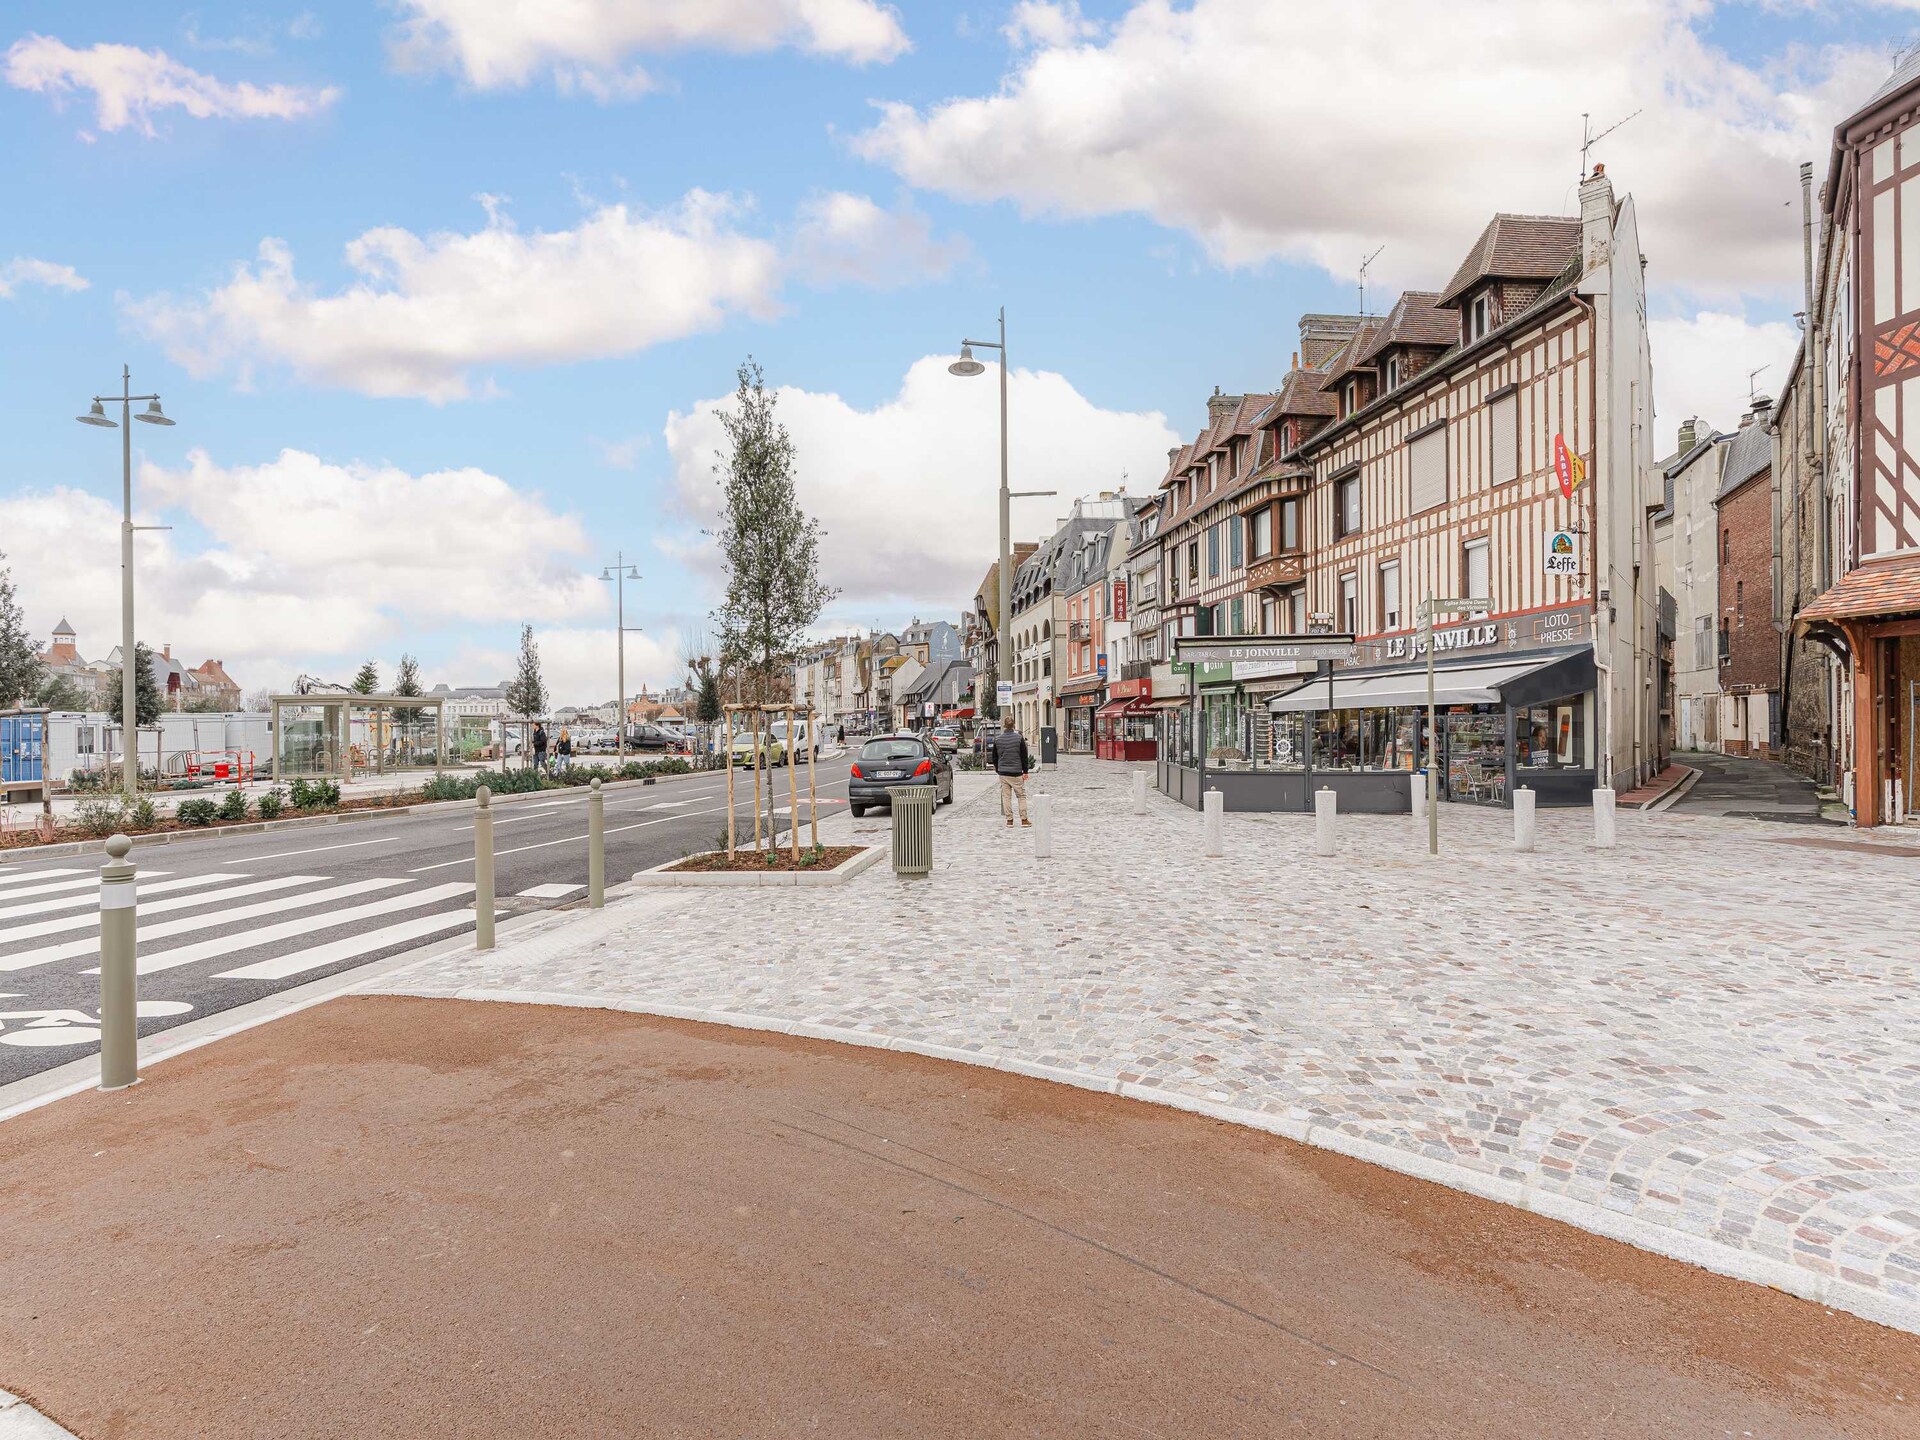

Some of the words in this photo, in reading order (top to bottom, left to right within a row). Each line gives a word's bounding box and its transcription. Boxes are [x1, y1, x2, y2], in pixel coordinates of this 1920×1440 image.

[1558, 446, 1569, 486] TABAC
[1547, 555, 1576, 572] Leffe
[1544, 613, 1569, 628] LOTO
[1386, 638, 1405, 658] LE
[1409, 625, 1497, 660] JNVILLE
[1540, 628, 1574, 643] PRESSE
[1229, 649, 1243, 658] LE
[1245, 647, 1301, 659] JOINVILLE
[1343, 655, 1361, 667] TABAC
